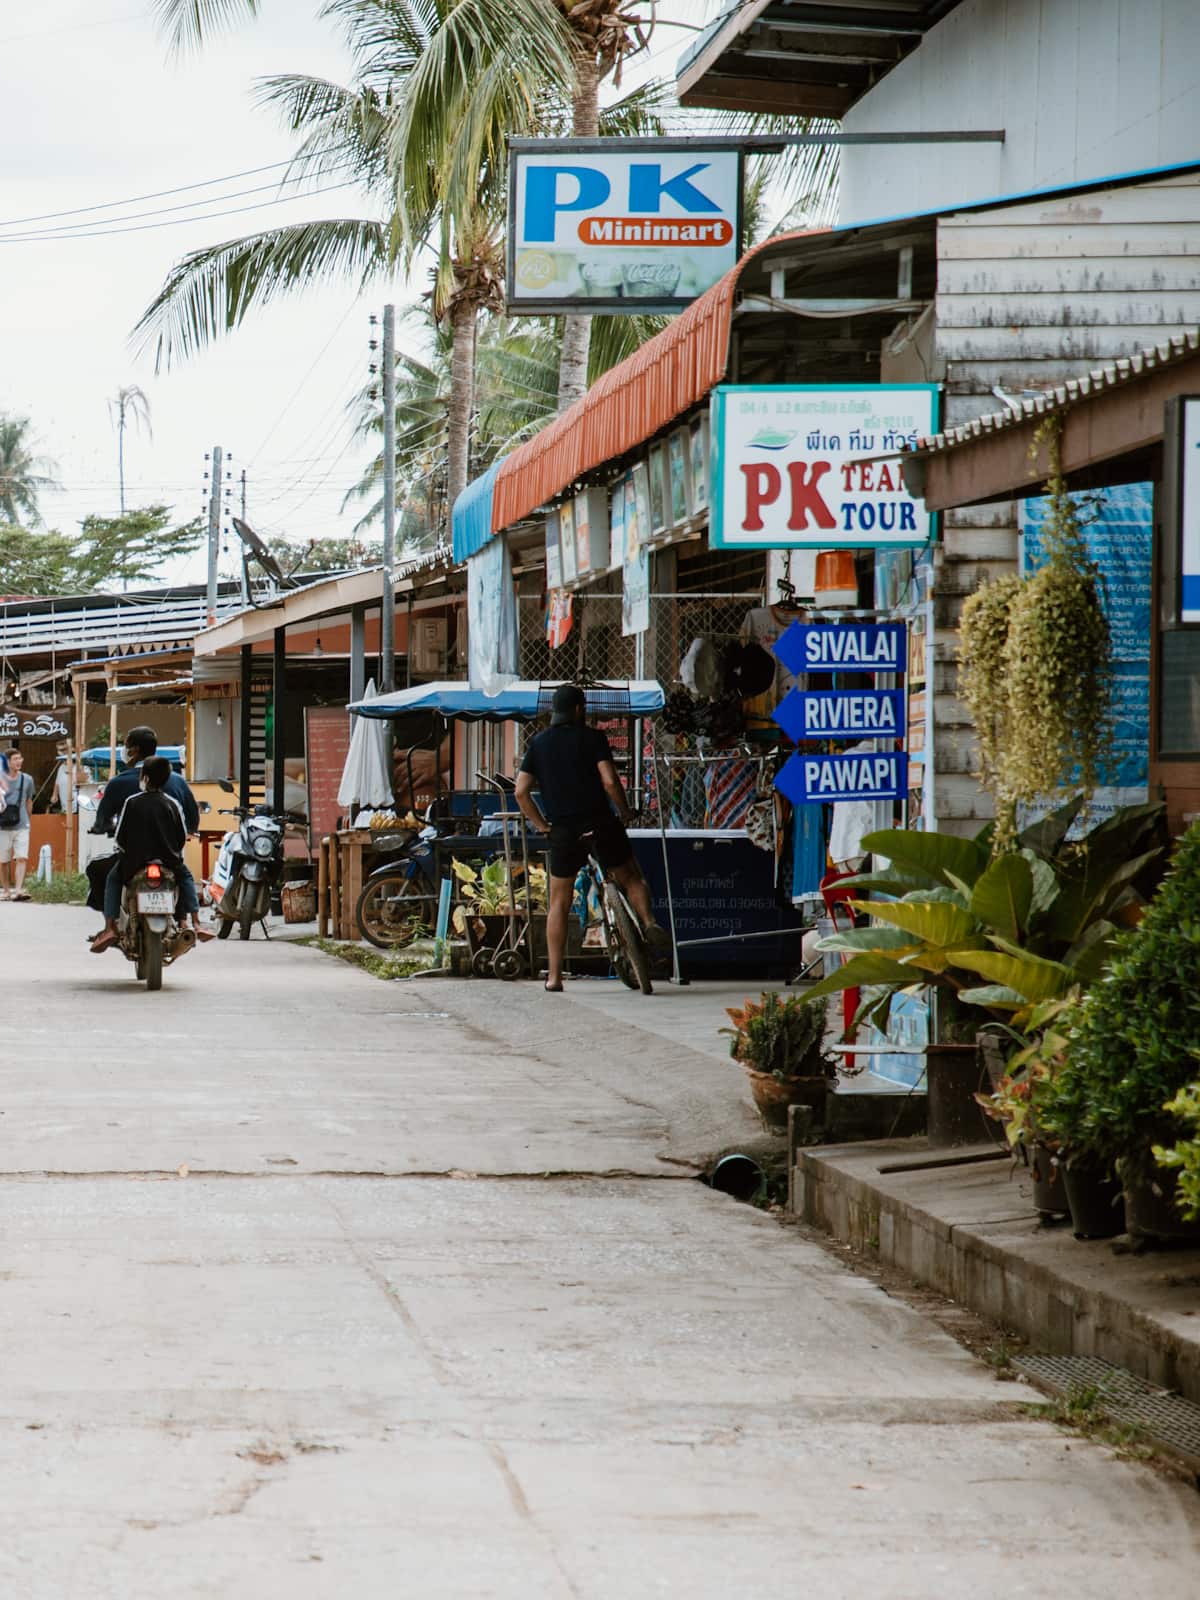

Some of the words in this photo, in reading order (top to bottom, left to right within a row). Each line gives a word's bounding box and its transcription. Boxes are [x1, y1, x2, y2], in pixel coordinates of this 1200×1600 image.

[523, 163, 723, 242] PK
[589, 220, 724, 241] Minimart
[806, 429, 841, 451] พีเค
[850, 429, 874, 451] ทีม
[739, 461, 837, 532] PK
[841, 502, 917, 531] TOUR
[805, 631, 897, 662] SIVALAI
[805, 696, 896, 729] RIVIERA
[805, 758, 897, 793] PAWAPI
